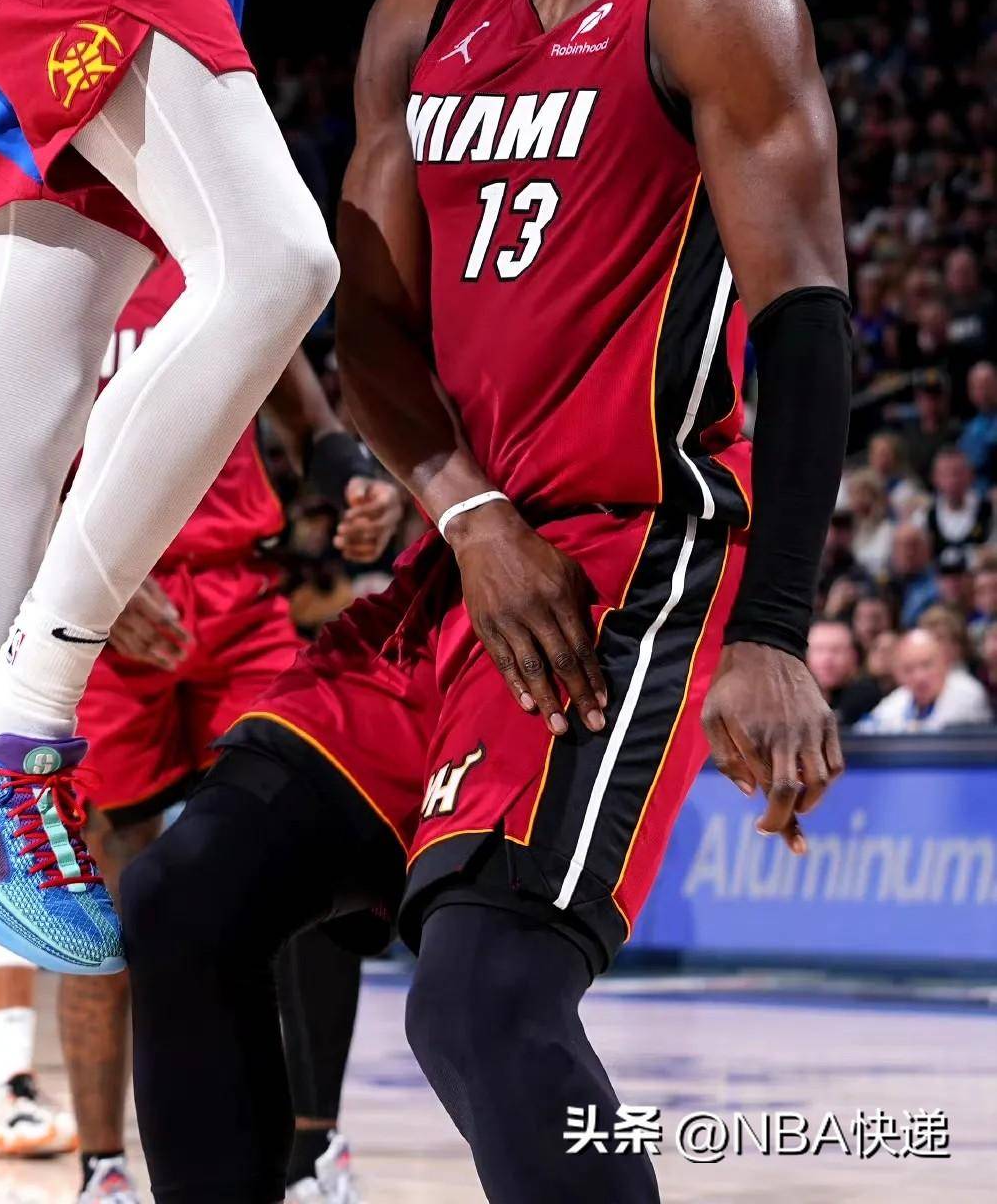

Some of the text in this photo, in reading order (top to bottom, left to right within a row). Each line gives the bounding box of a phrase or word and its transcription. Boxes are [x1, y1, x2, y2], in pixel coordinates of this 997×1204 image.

[550, 37, 610, 56] Robinhood
[462, 178, 561, 282] 13
[684, 808, 997, 902] Aluminum
